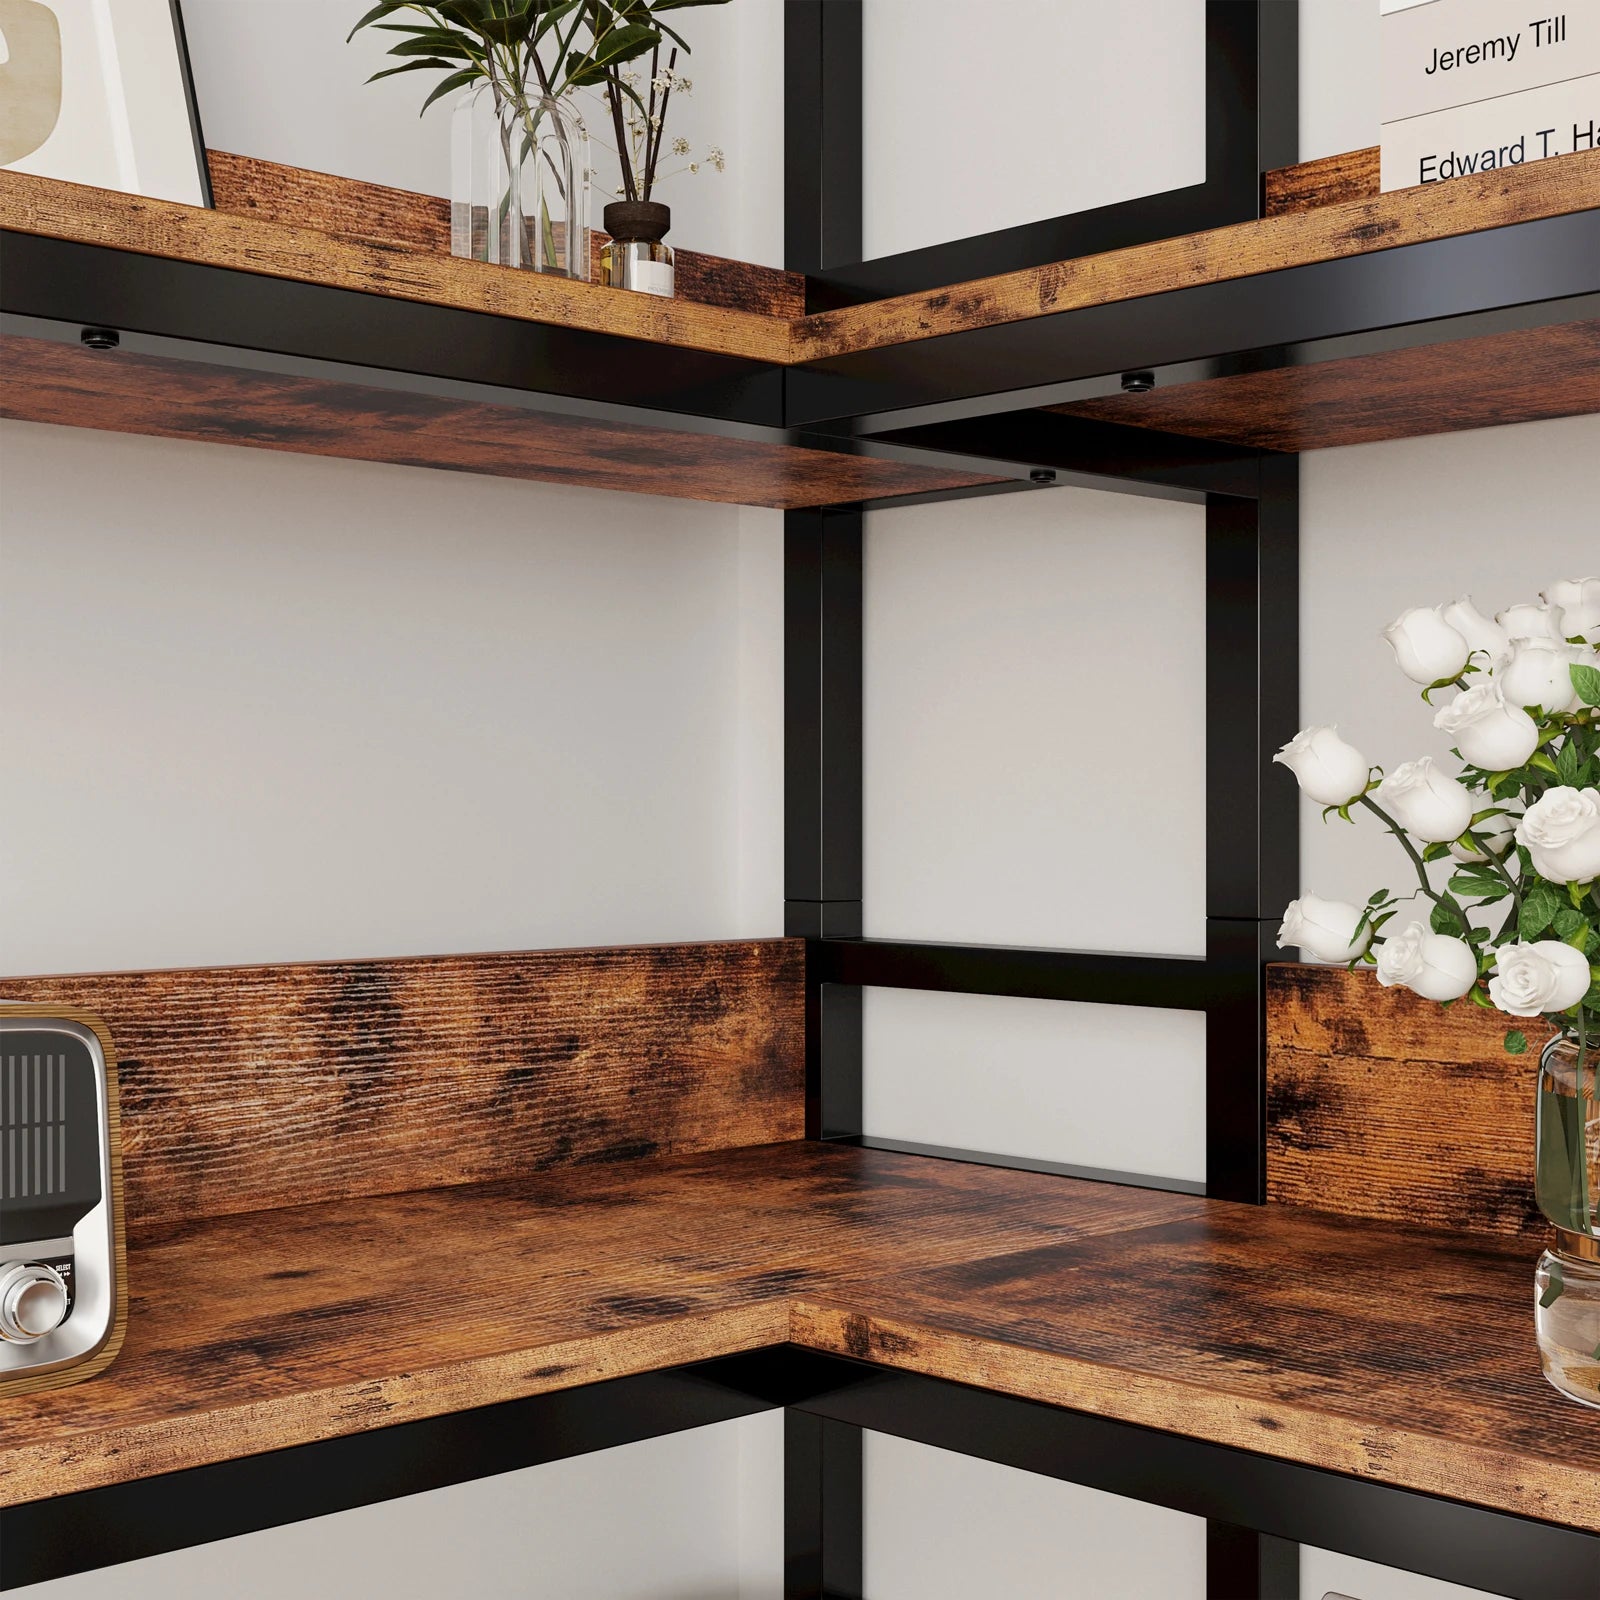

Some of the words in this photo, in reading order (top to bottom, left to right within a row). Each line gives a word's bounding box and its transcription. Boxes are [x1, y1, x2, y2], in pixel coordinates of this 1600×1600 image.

[1425, 33, 1521, 75] Jeremy
[1529, 15, 1566, 47] Till
[1419, 135, 1525, 184] Edward
[1535, 128, 1559, 158] T.
[1573, 120, 1600, 151] H
